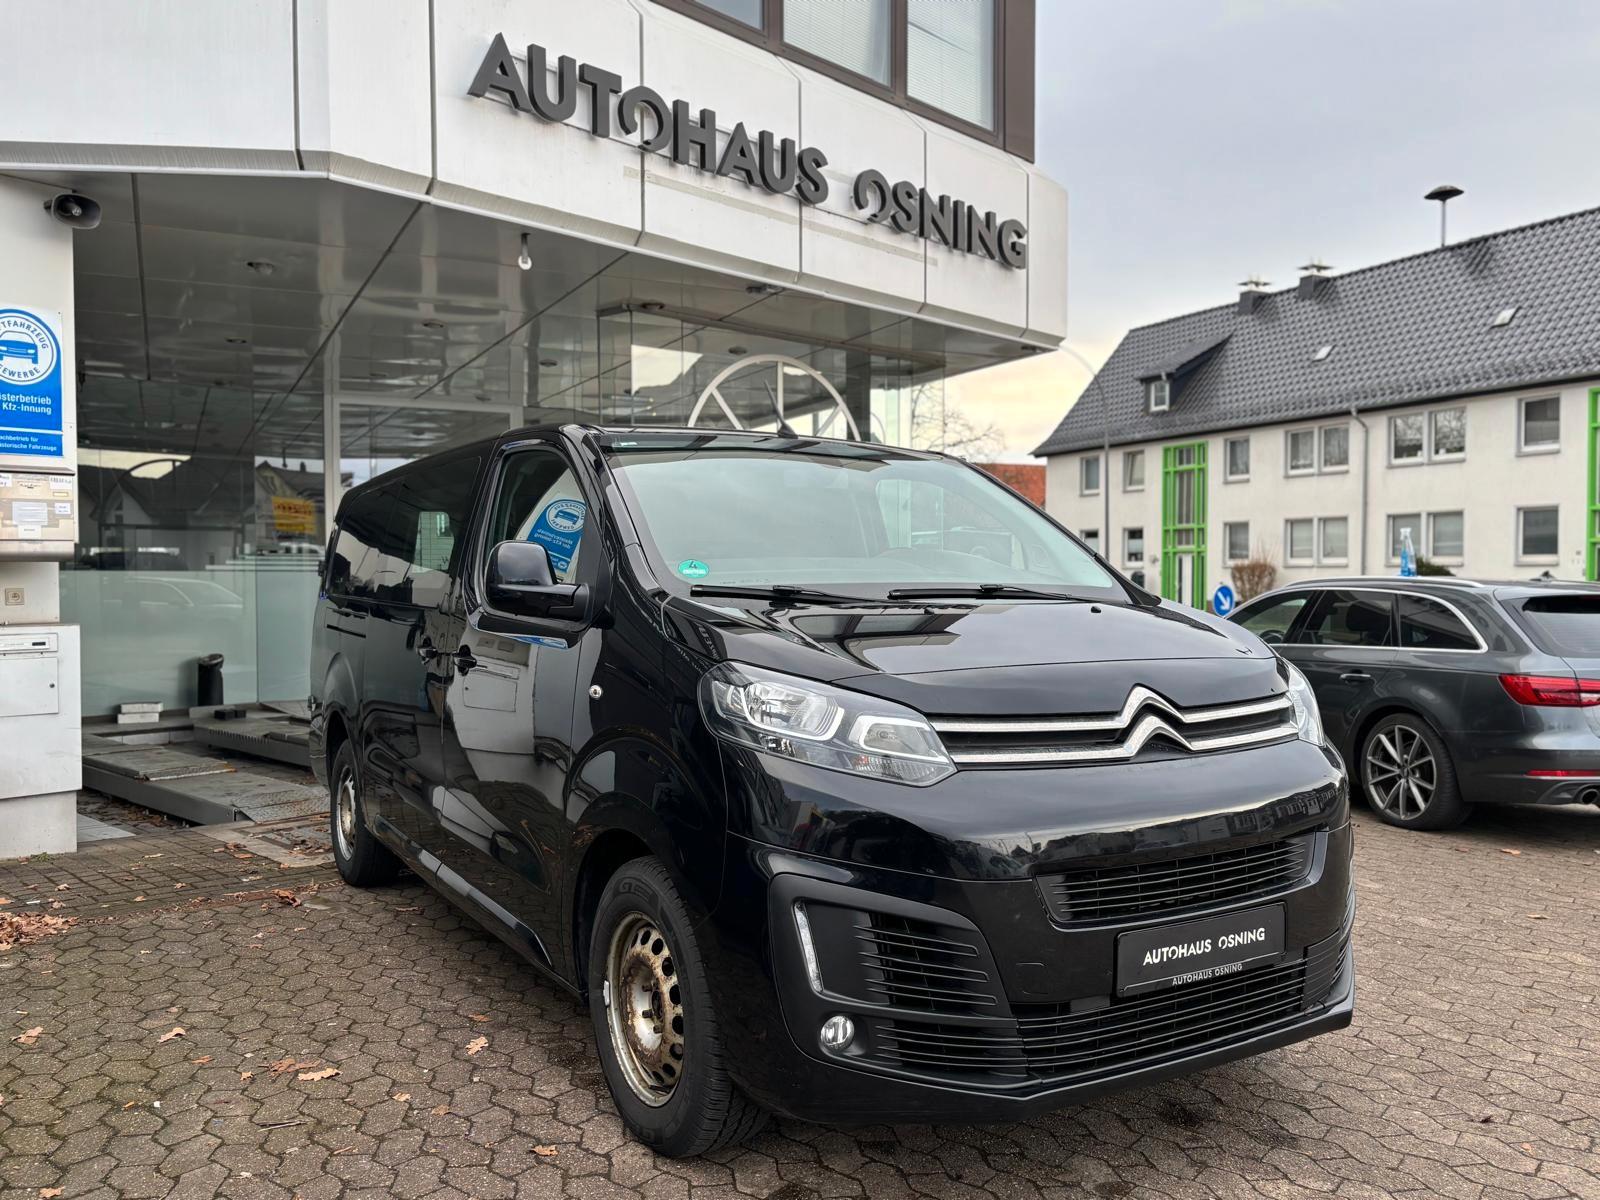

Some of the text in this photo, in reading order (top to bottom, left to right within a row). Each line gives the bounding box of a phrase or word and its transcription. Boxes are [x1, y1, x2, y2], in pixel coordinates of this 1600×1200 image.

[466, 32, 1027, 269] AUTOHAUS OSNING
[0, 320, 49, 349] TFAHRZEUG
[2, 401, 52, 415] Kfz-Innung
[1142, 927, 1266, 966] AUTOHAUS OSNING
[1172, 963, 1243, 986] AUTOHAUS OSNING
